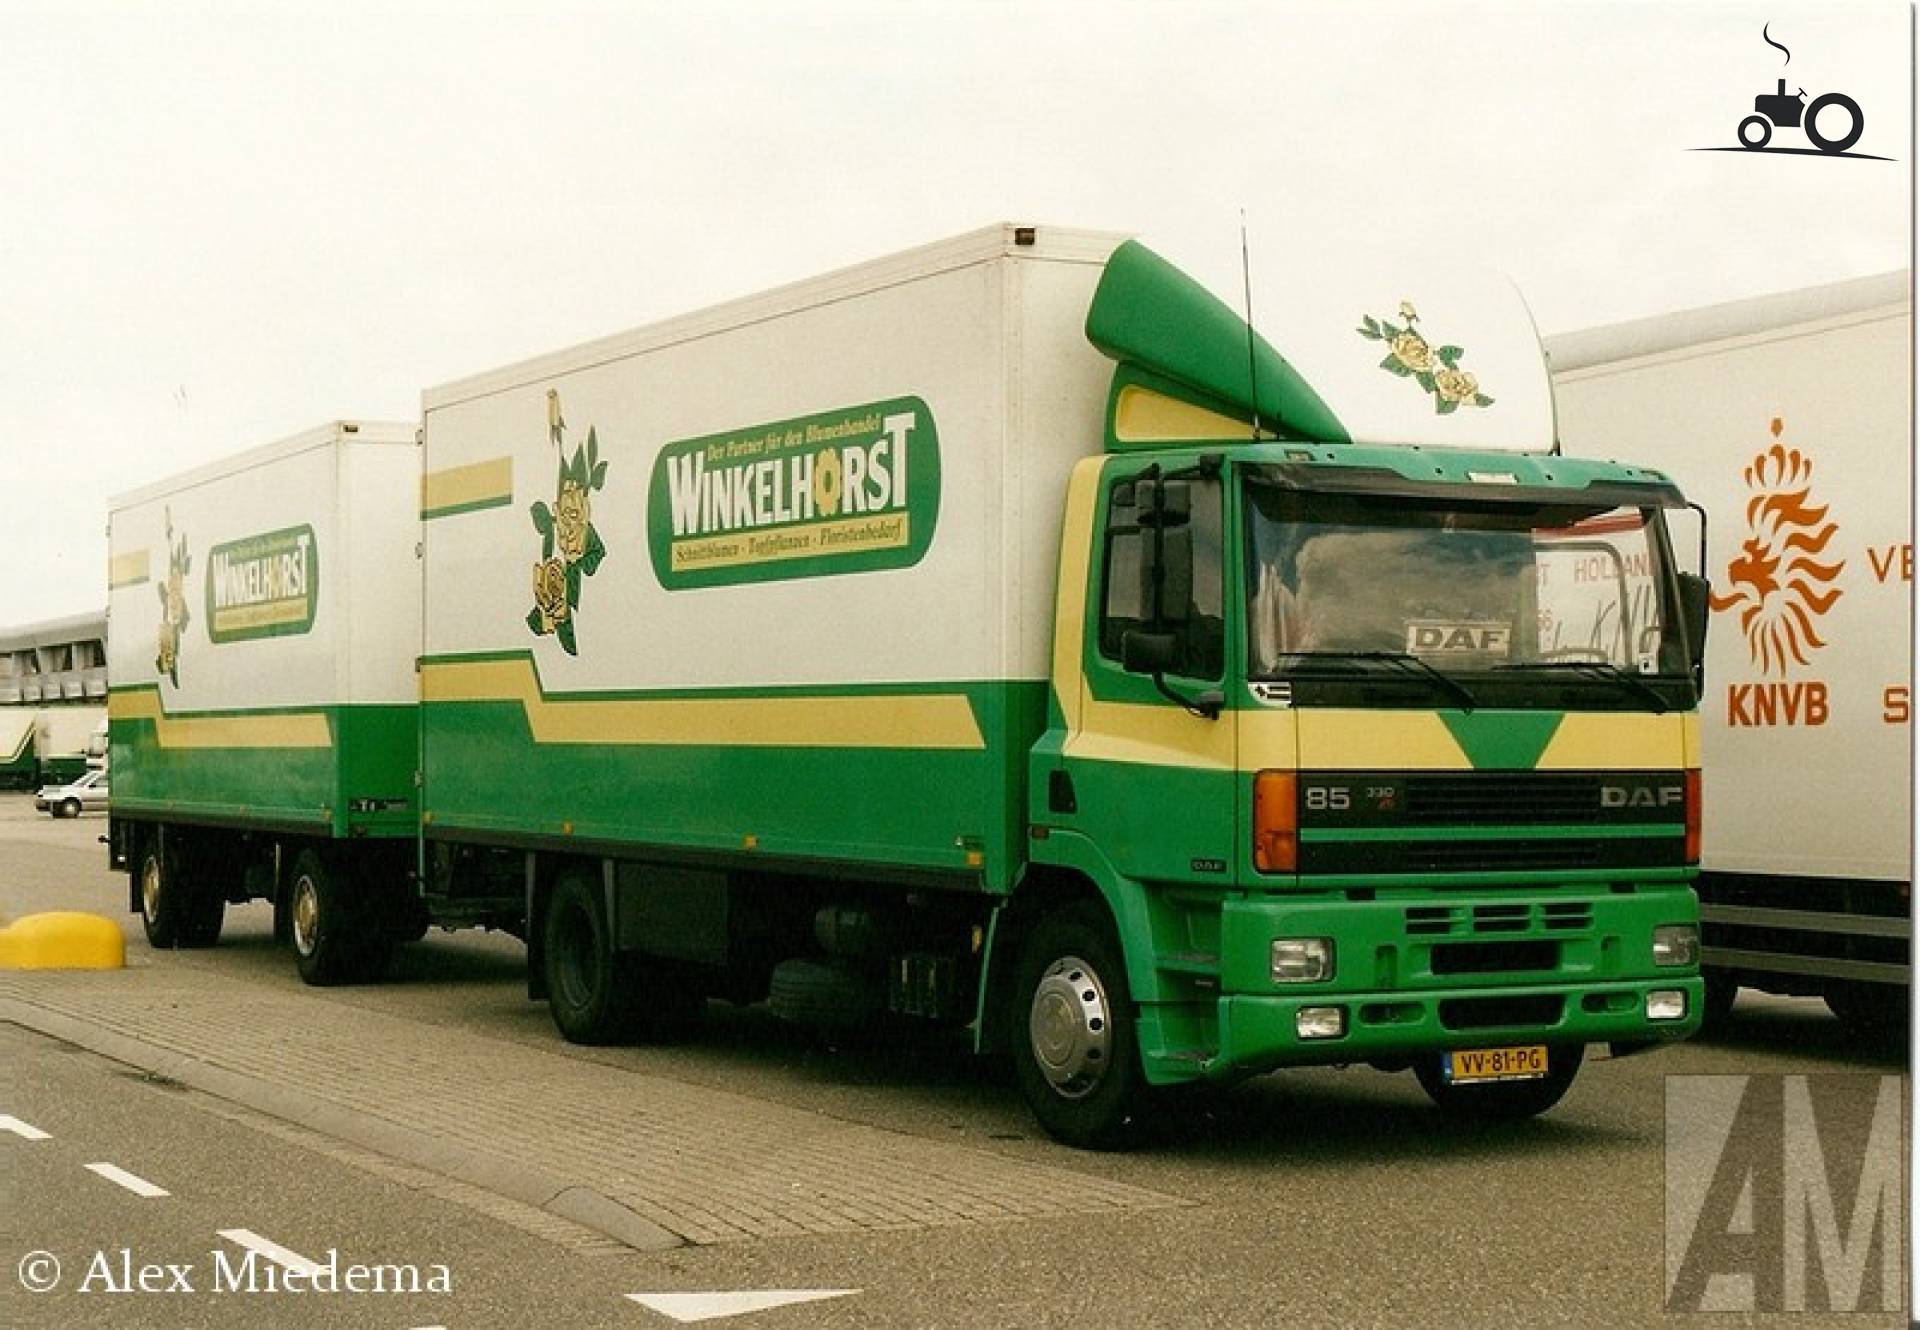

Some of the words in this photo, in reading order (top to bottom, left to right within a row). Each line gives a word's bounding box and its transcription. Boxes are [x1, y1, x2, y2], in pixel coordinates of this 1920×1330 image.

[667, 412, 915, 536] WINKELHORST
[1415, 627, 1504, 650] DAF
[1727, 682, 1828, 726] KNVB
[1306, 786, 1350, 810] 85
[1600, 786, 1684, 808] DAF
[1461, 1048, 1541, 1073] VV-81-PG
